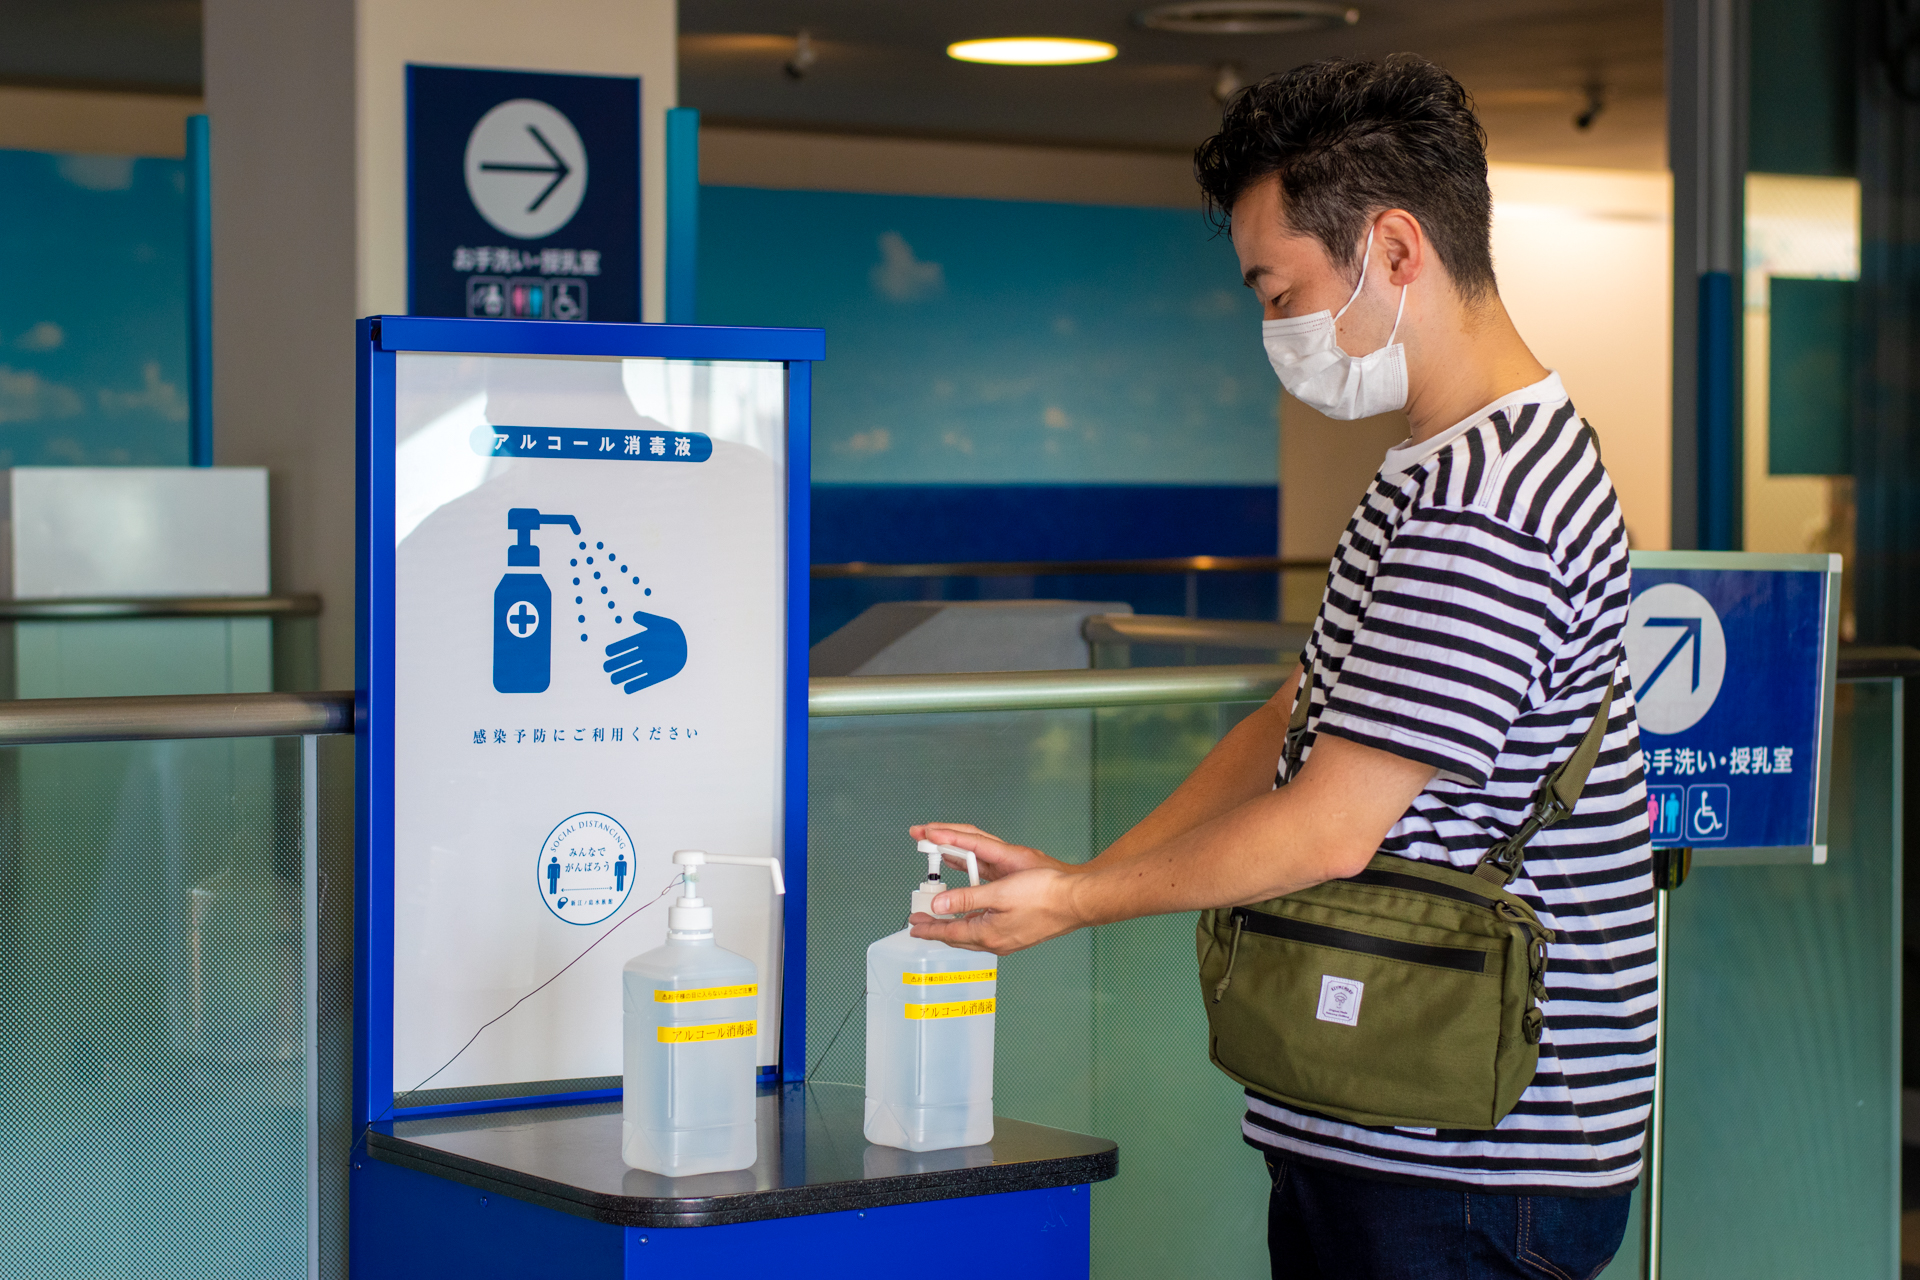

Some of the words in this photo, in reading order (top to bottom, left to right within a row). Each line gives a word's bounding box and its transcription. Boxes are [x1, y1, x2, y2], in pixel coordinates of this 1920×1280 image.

[493, 433, 692, 457] アルコール消毒液
[472, 726, 698, 744] 感染予防にご利用ください
[550, 825, 576, 853] SOCIAL
[578, 820, 626, 850] DISTANCING
[569, 846, 606, 858] みんなで
[565, 861, 610, 873] がんばろう
[919, 1000, 993, 1018] アルコール消毒液
[672, 1022, 754, 1042] アルコール消毒液
